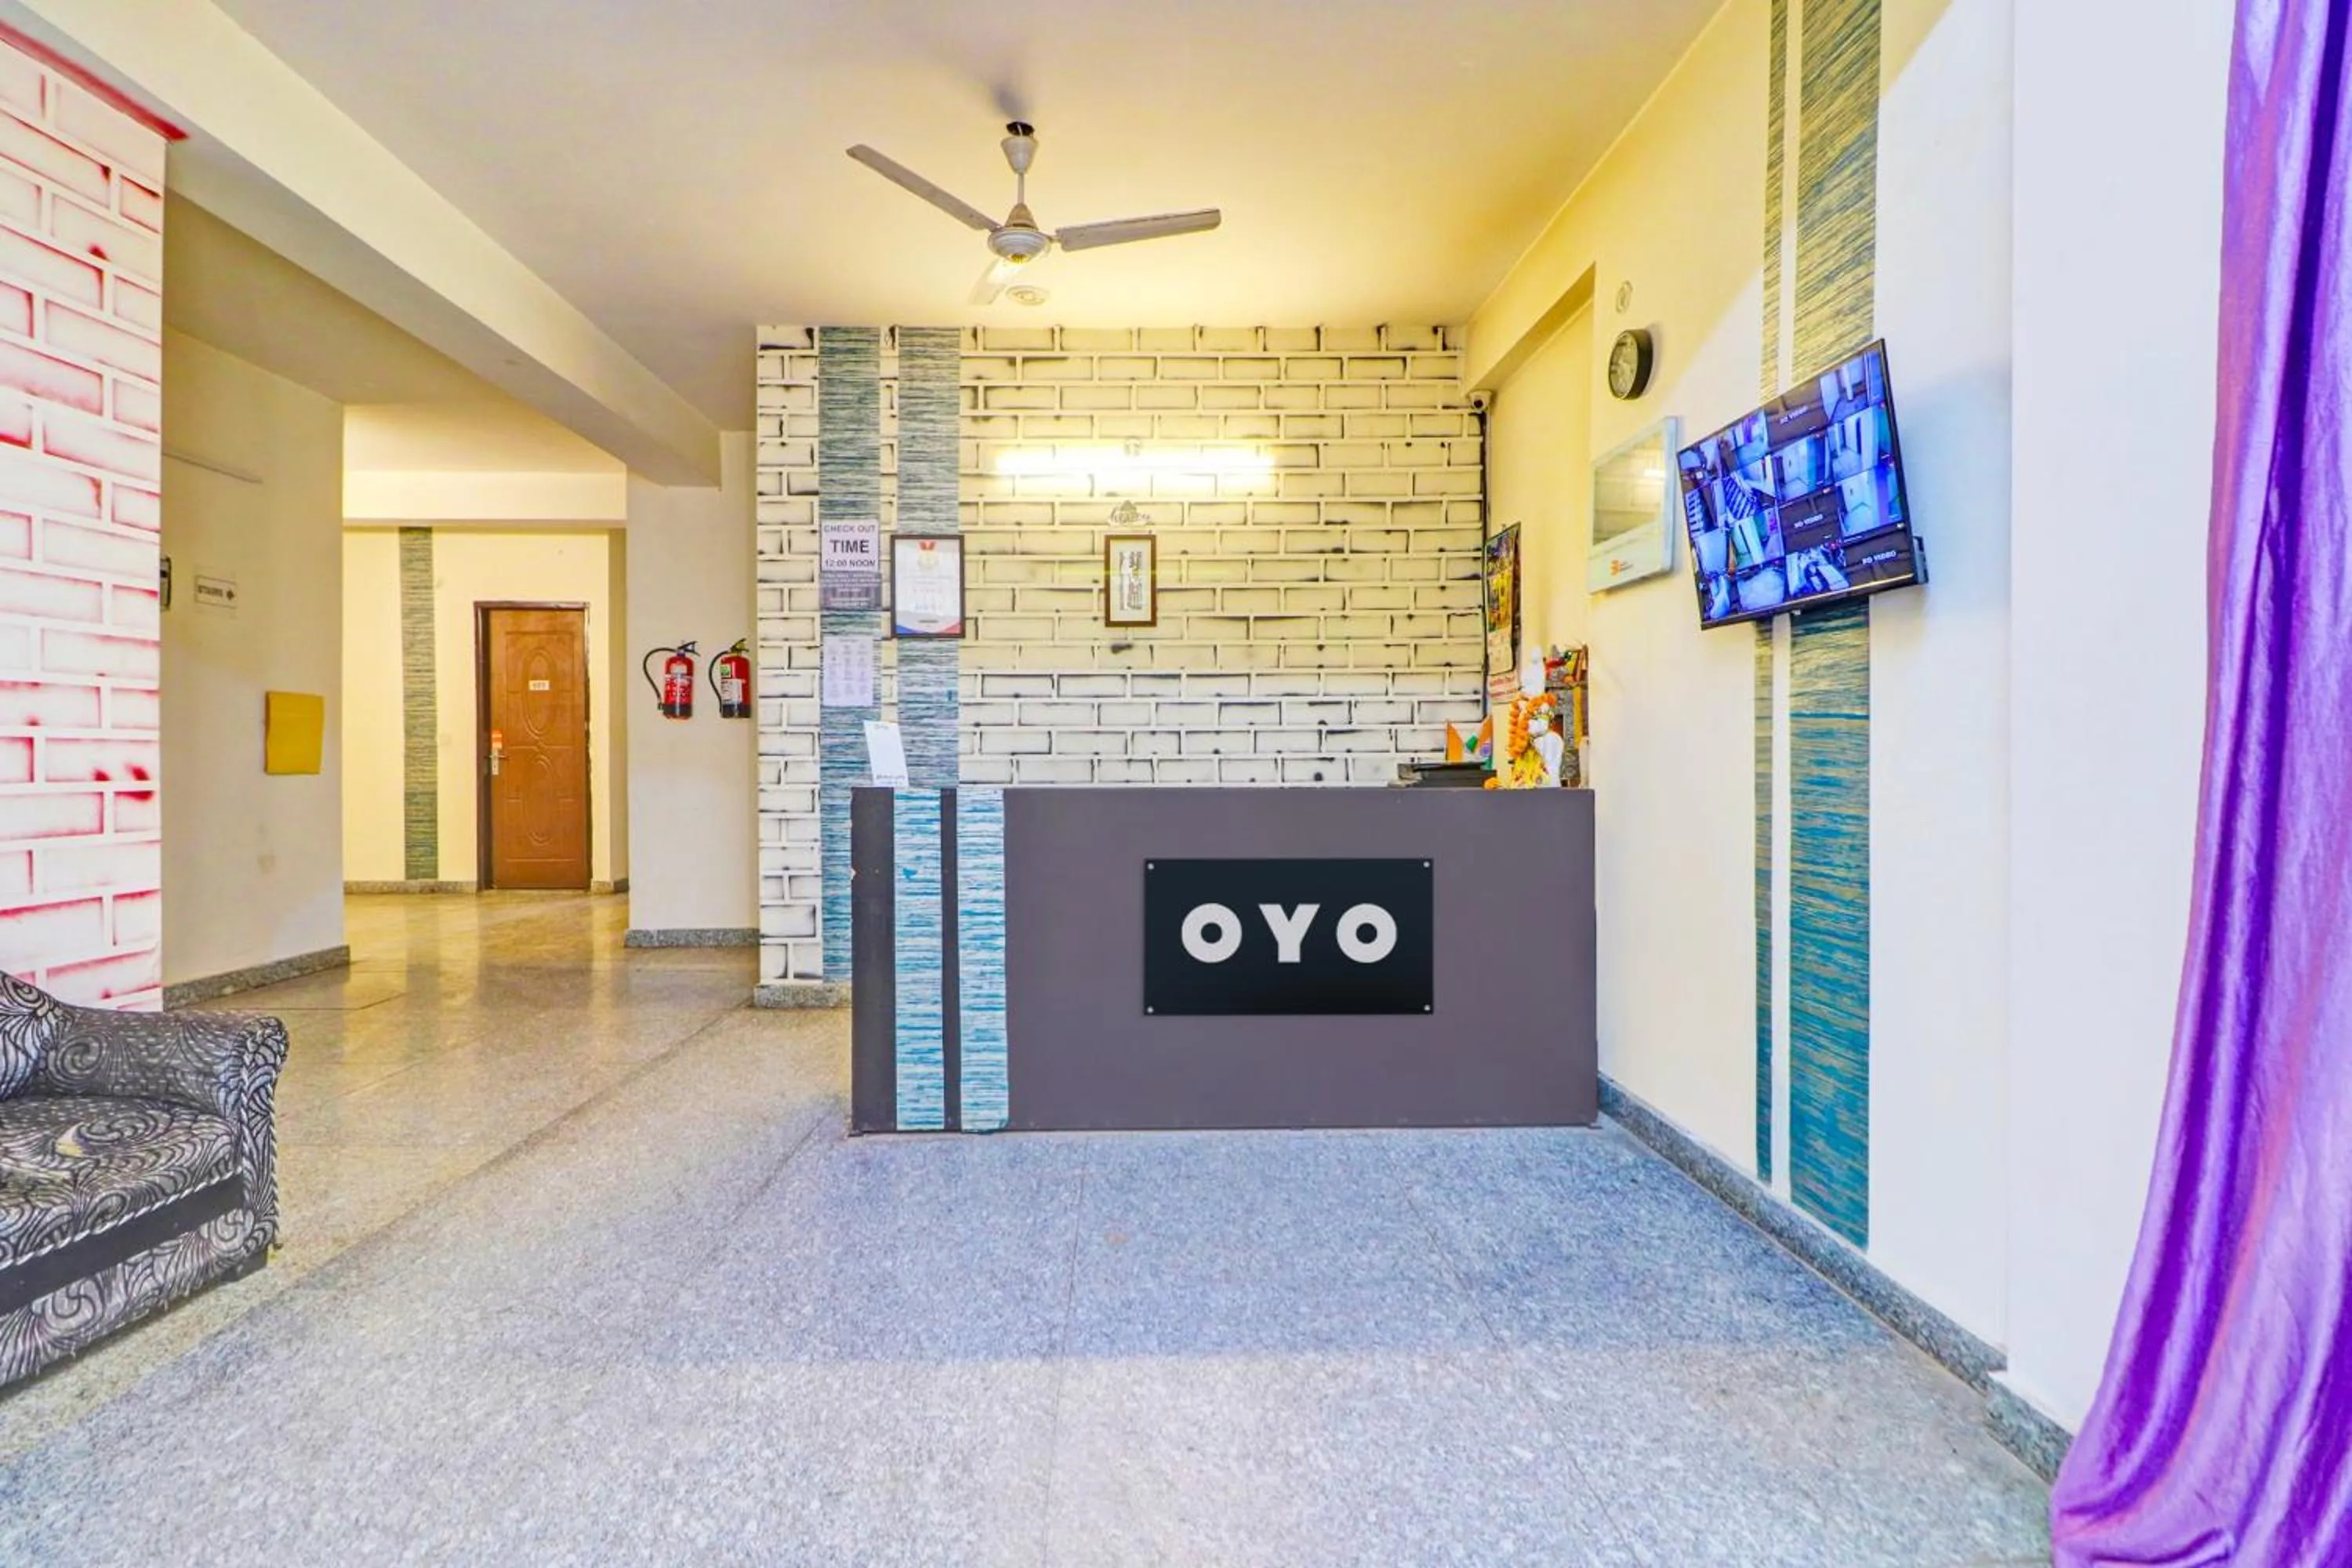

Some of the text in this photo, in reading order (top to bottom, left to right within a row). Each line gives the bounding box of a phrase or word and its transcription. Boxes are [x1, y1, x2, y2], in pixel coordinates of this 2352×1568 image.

[1804, 514, 1823, 524] VIDEO
[824, 524, 876, 533] CHECK OUT
[829, 539, 869, 554] TIME
[1873, 550, 1896, 561] VIDEO
[849, 559, 876, 568] NOON
[1181, 903, 1397, 964] OYO
